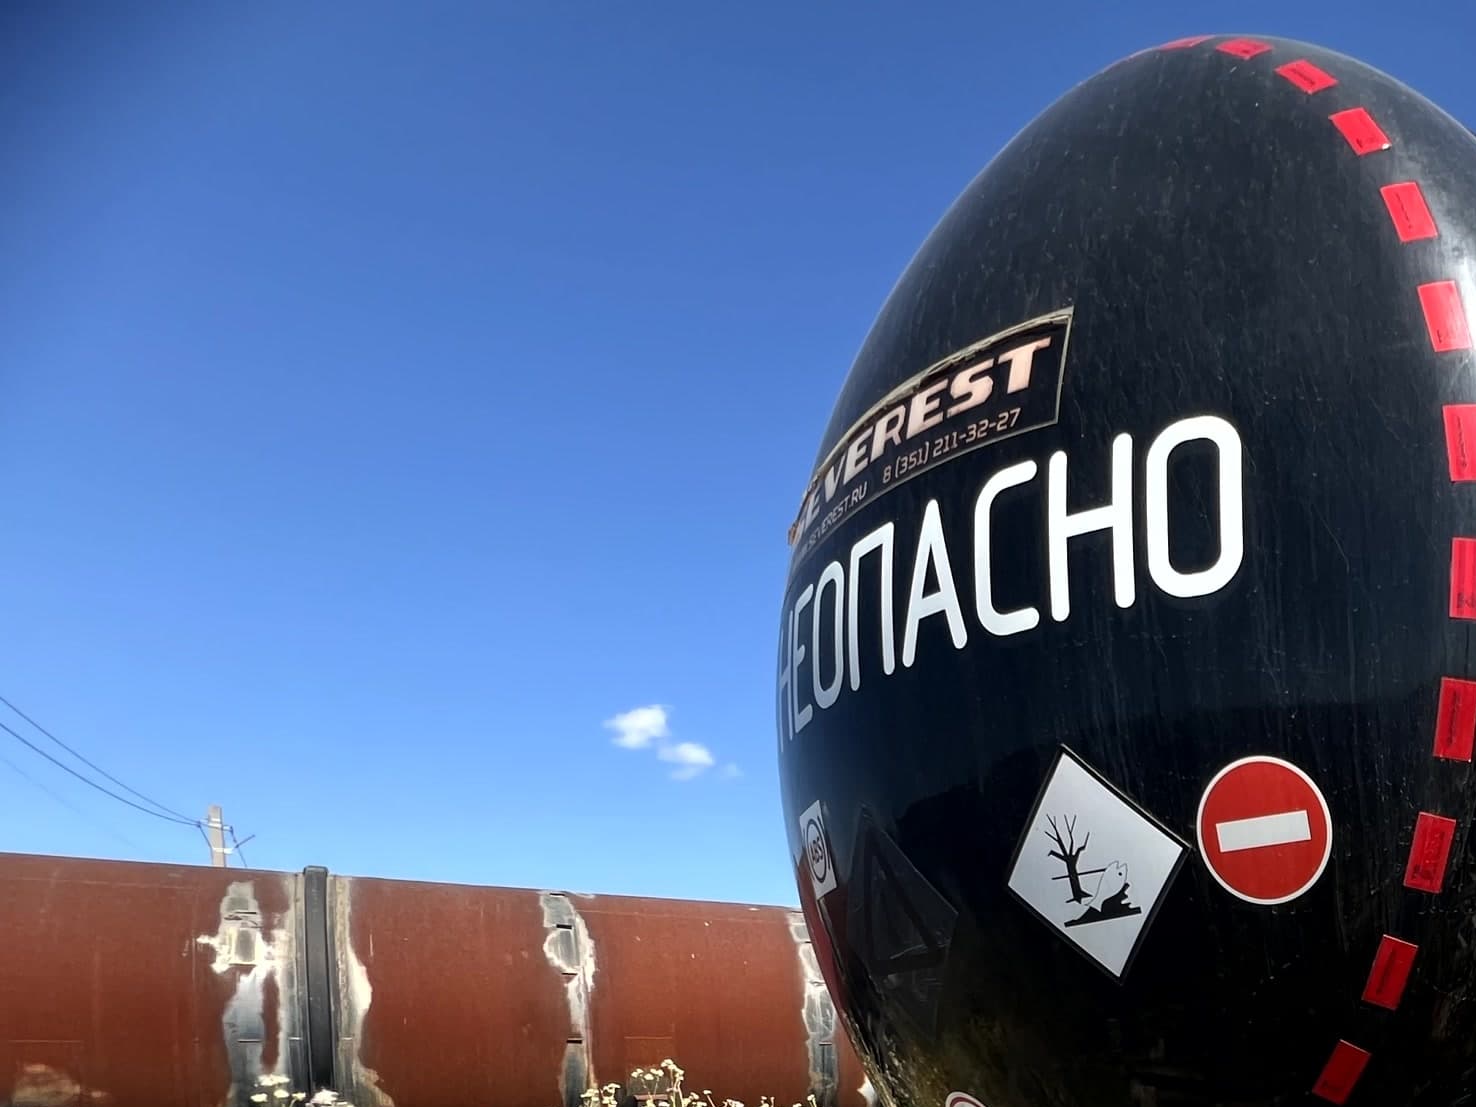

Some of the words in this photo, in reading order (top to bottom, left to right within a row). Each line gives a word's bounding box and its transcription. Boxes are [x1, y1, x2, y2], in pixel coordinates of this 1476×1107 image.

[882, 465, 892, 484] 8
[895, 441, 930, 479] (351)
[932, 407, 1021, 458] 211-32-27
[809, 835, 824, 864] ABS
